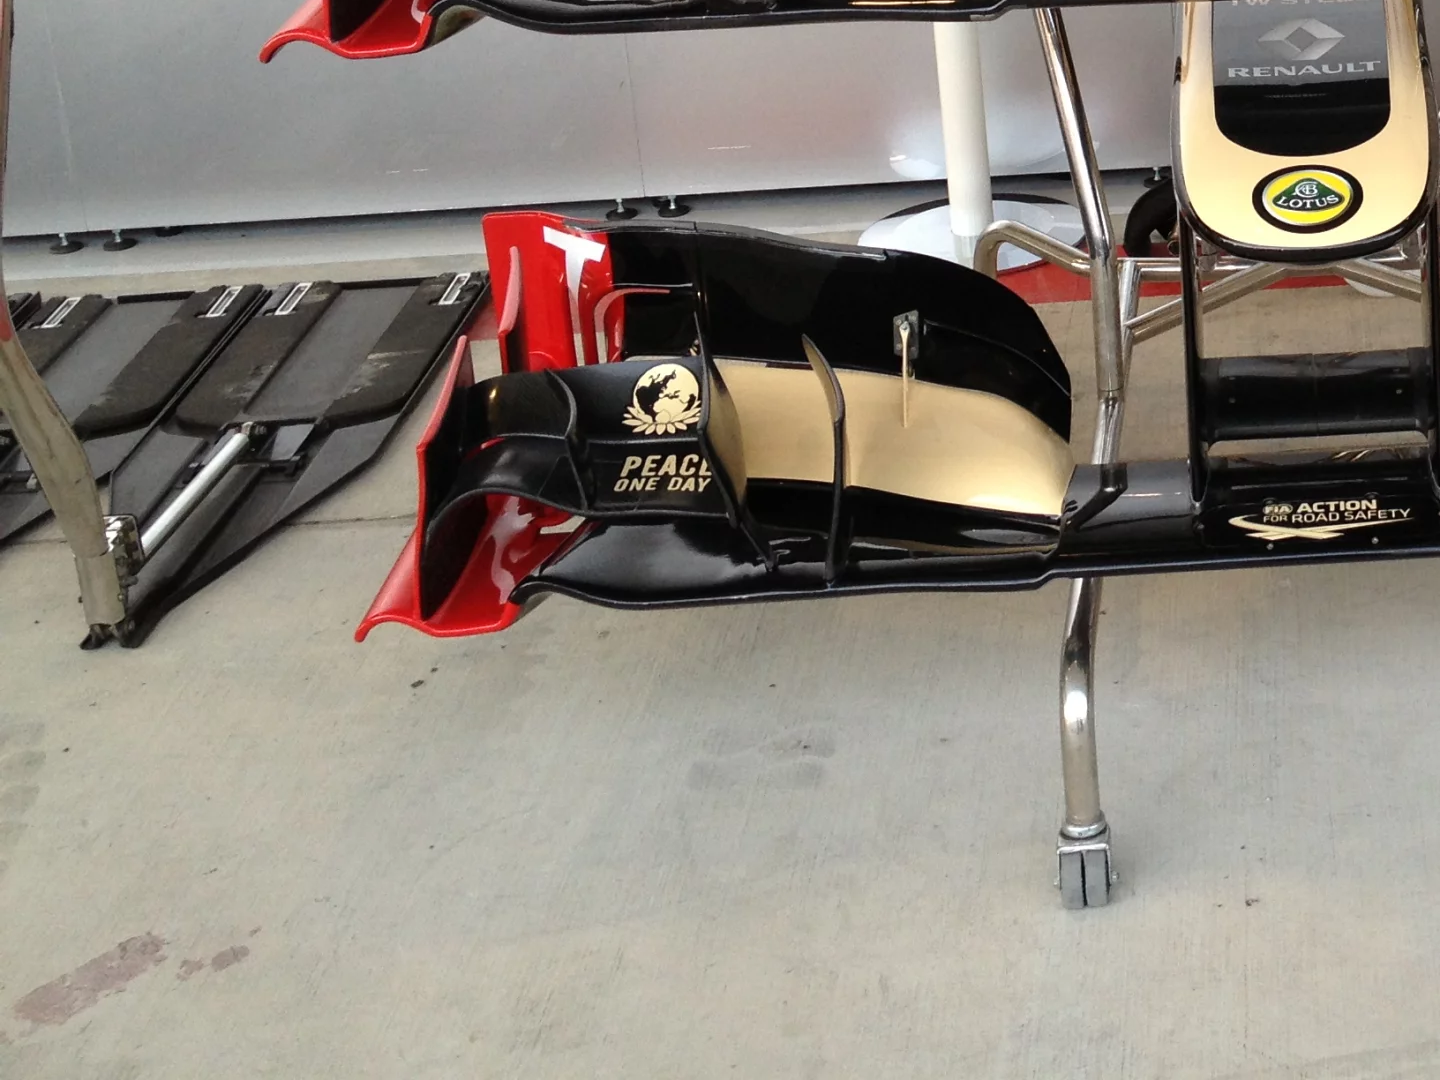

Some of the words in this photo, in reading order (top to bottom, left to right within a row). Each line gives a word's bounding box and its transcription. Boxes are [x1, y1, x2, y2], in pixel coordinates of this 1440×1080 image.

[1228, 60, 1381, 78] RENAULT
[1276, 194, 1340, 209] LOTUS
[613, 477, 661, 492] ONE
[667, 477, 712, 492] DAY
[1263, 504, 1294, 515] FIA
[1297, 499, 1378, 513] ACTION
[1263, 514, 1288, 523] FOR
[1292, 511, 1340, 523] ROAD
[1344, 508, 1411, 520] SAFETY
